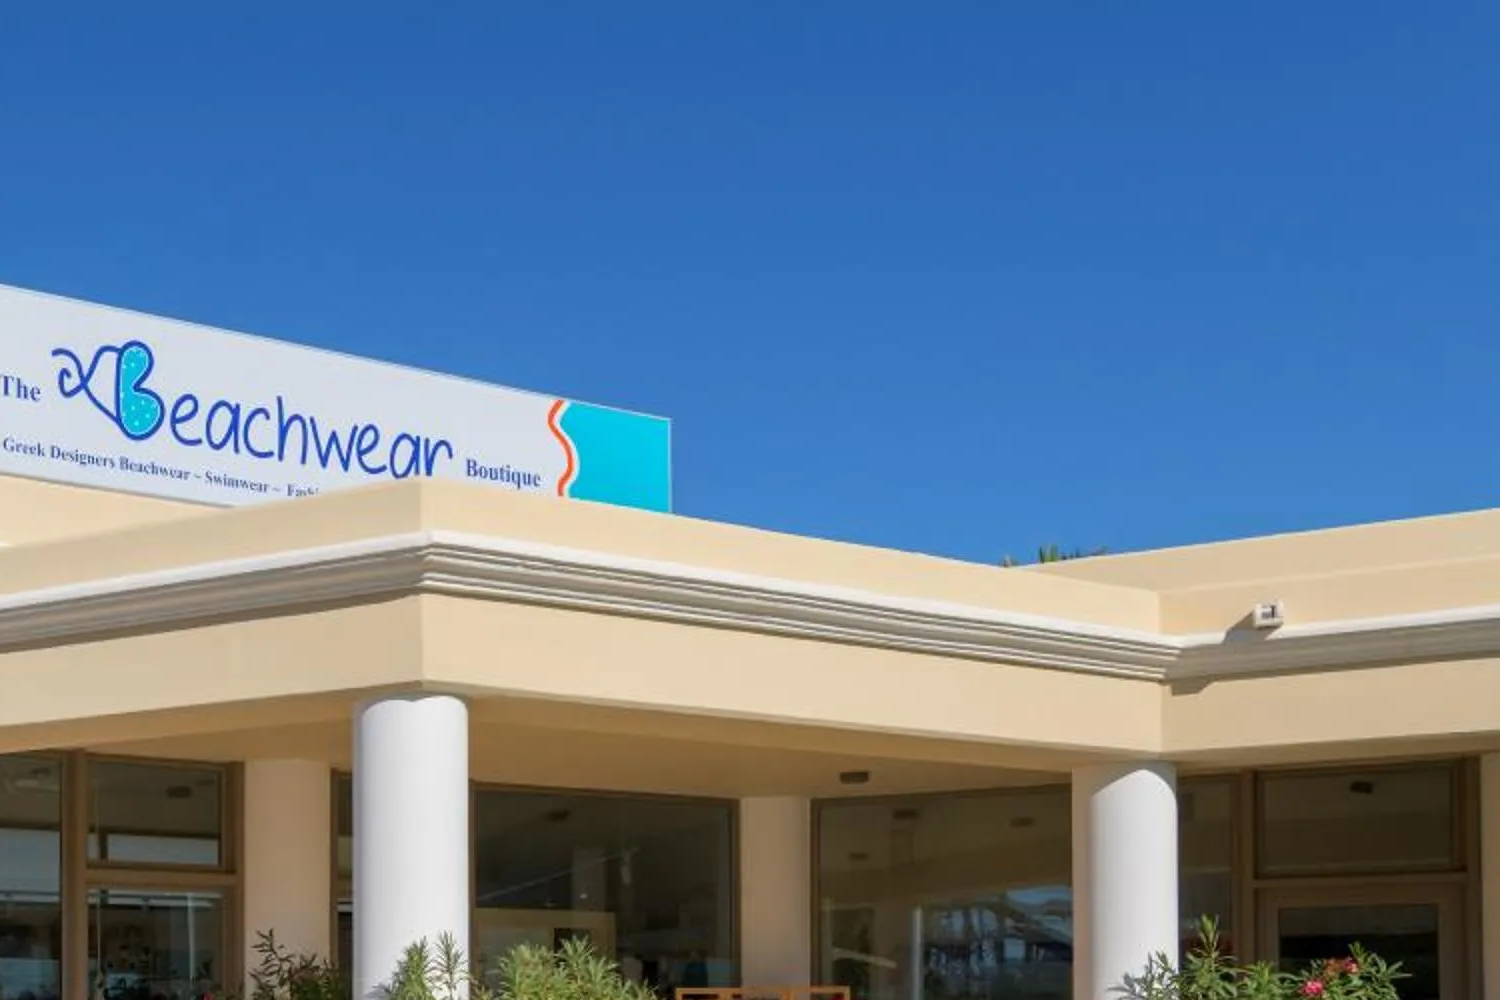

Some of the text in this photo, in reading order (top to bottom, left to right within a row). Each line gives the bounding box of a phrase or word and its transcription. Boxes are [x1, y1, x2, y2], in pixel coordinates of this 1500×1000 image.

[3, 436, 46, 457] Greek
[49, 444, 115, 468] Designers
[119, 455, 191, 481] Beachwear
[205, 470, 270, 493] Swimwear
[52, 340, 453, 479] Beachwear
[466, 458, 541, 490] Boutique
